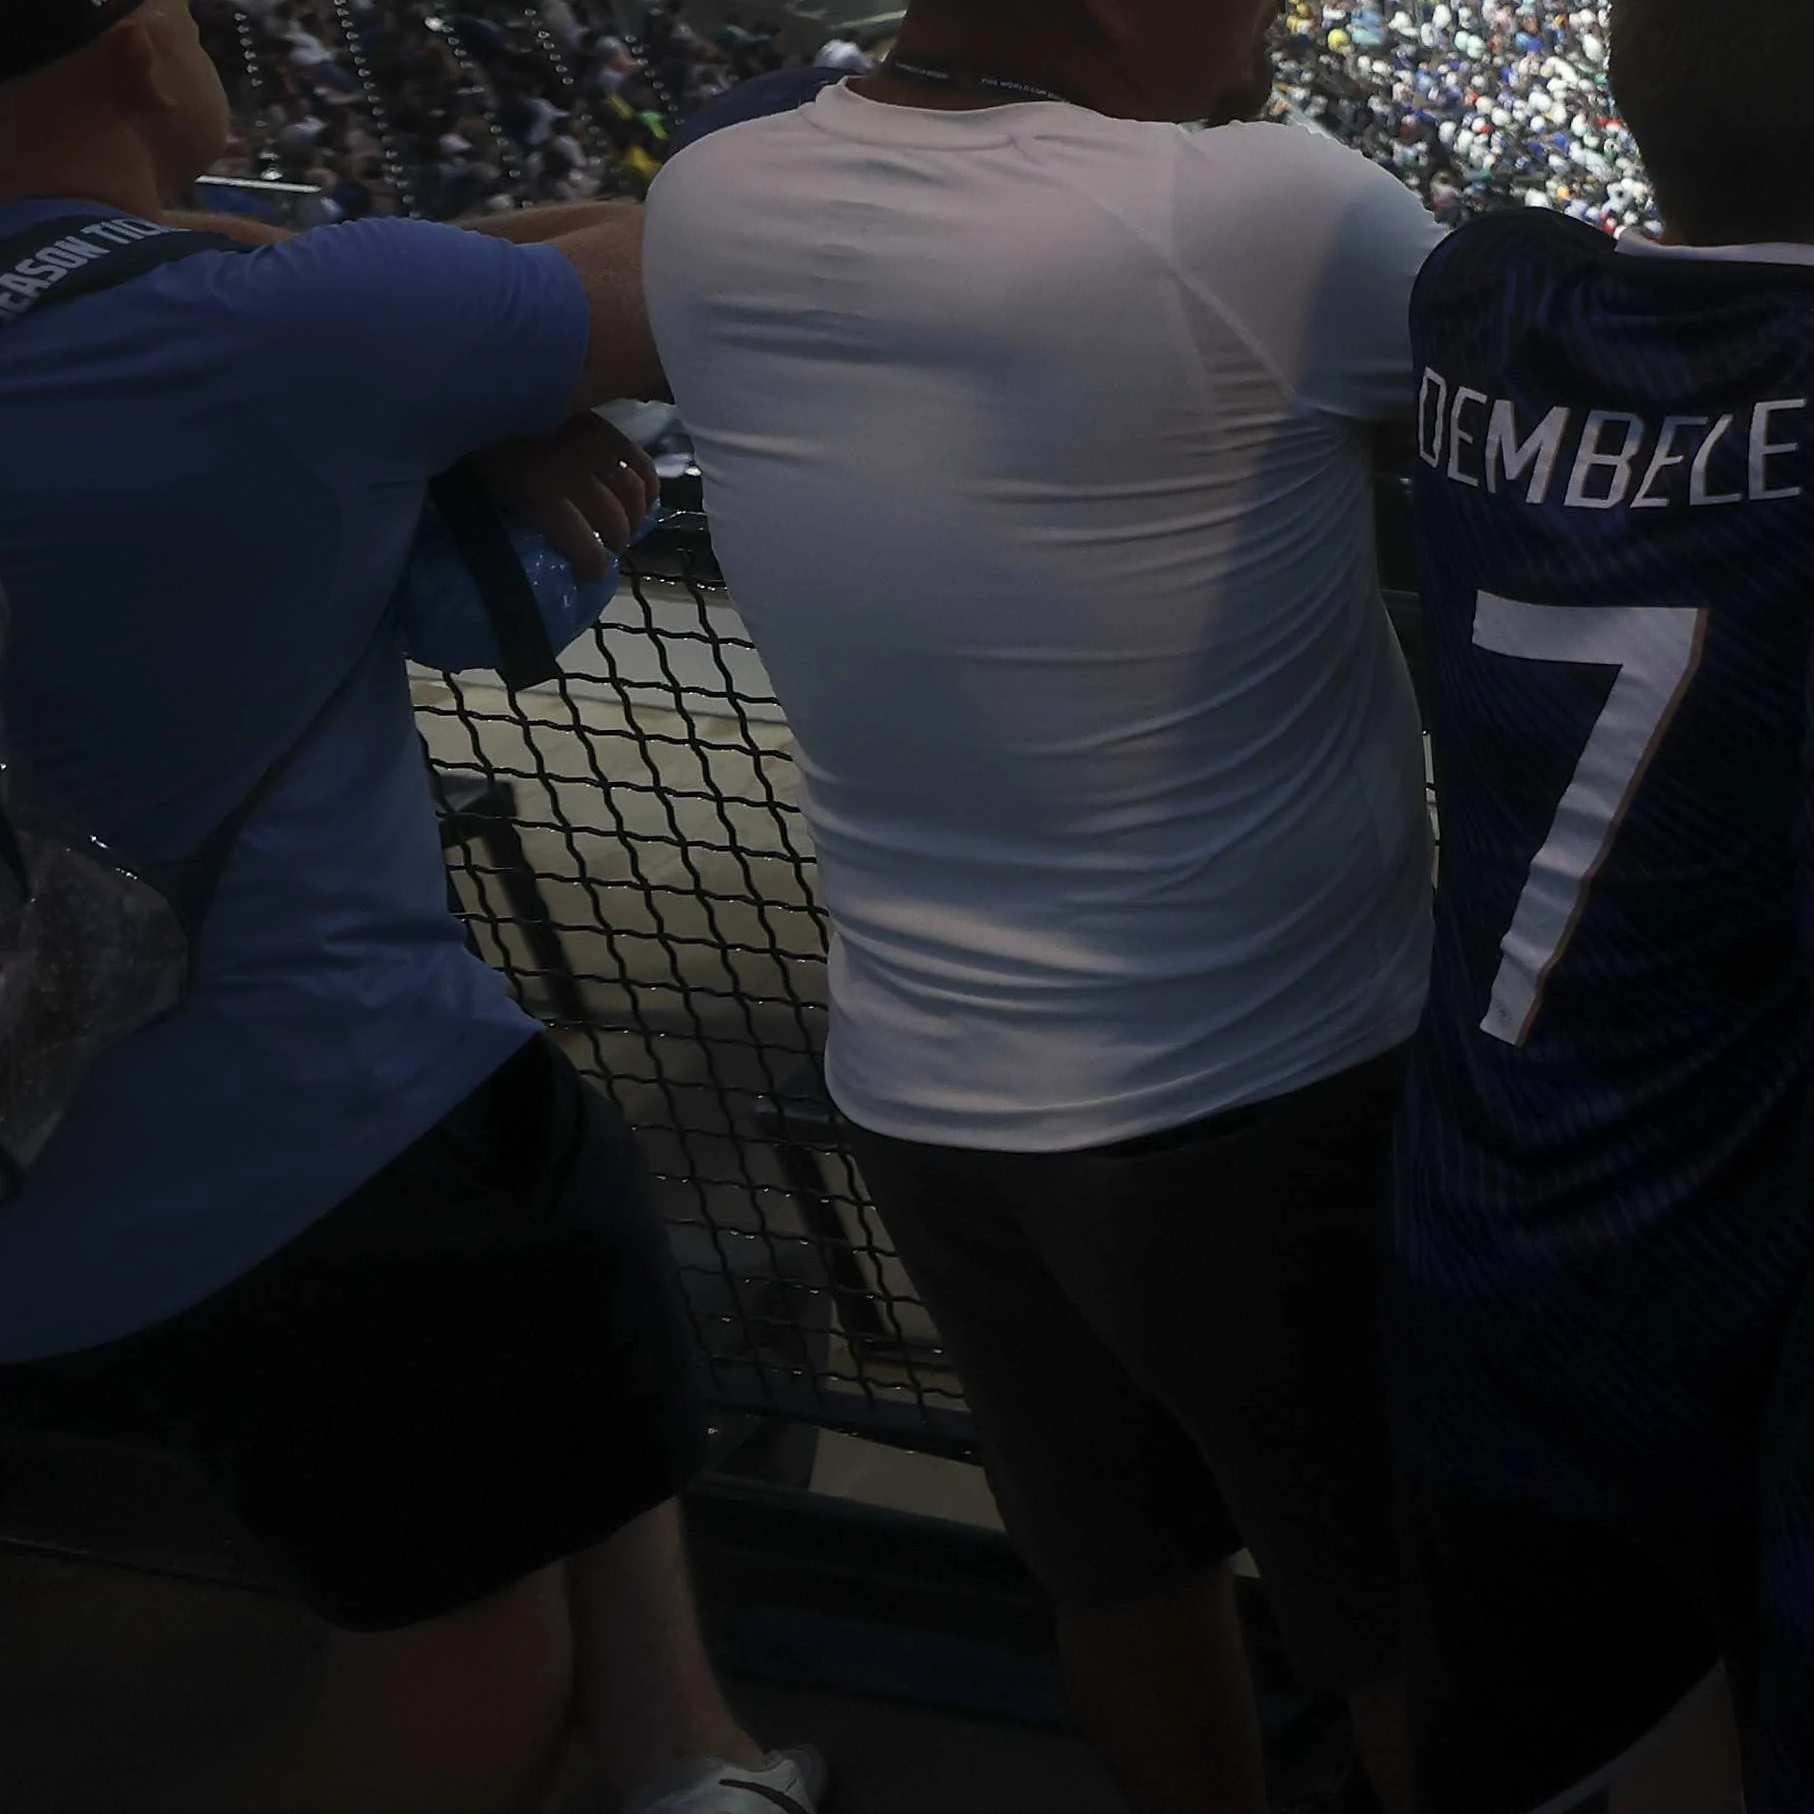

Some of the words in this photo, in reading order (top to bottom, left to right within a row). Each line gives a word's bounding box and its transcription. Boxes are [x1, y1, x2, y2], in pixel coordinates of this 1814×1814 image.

[80, 218, 192, 244] TIC
[1418, 366, 1807, 509] DEMBELE
[1472, 590, 1706, 1048] 7
